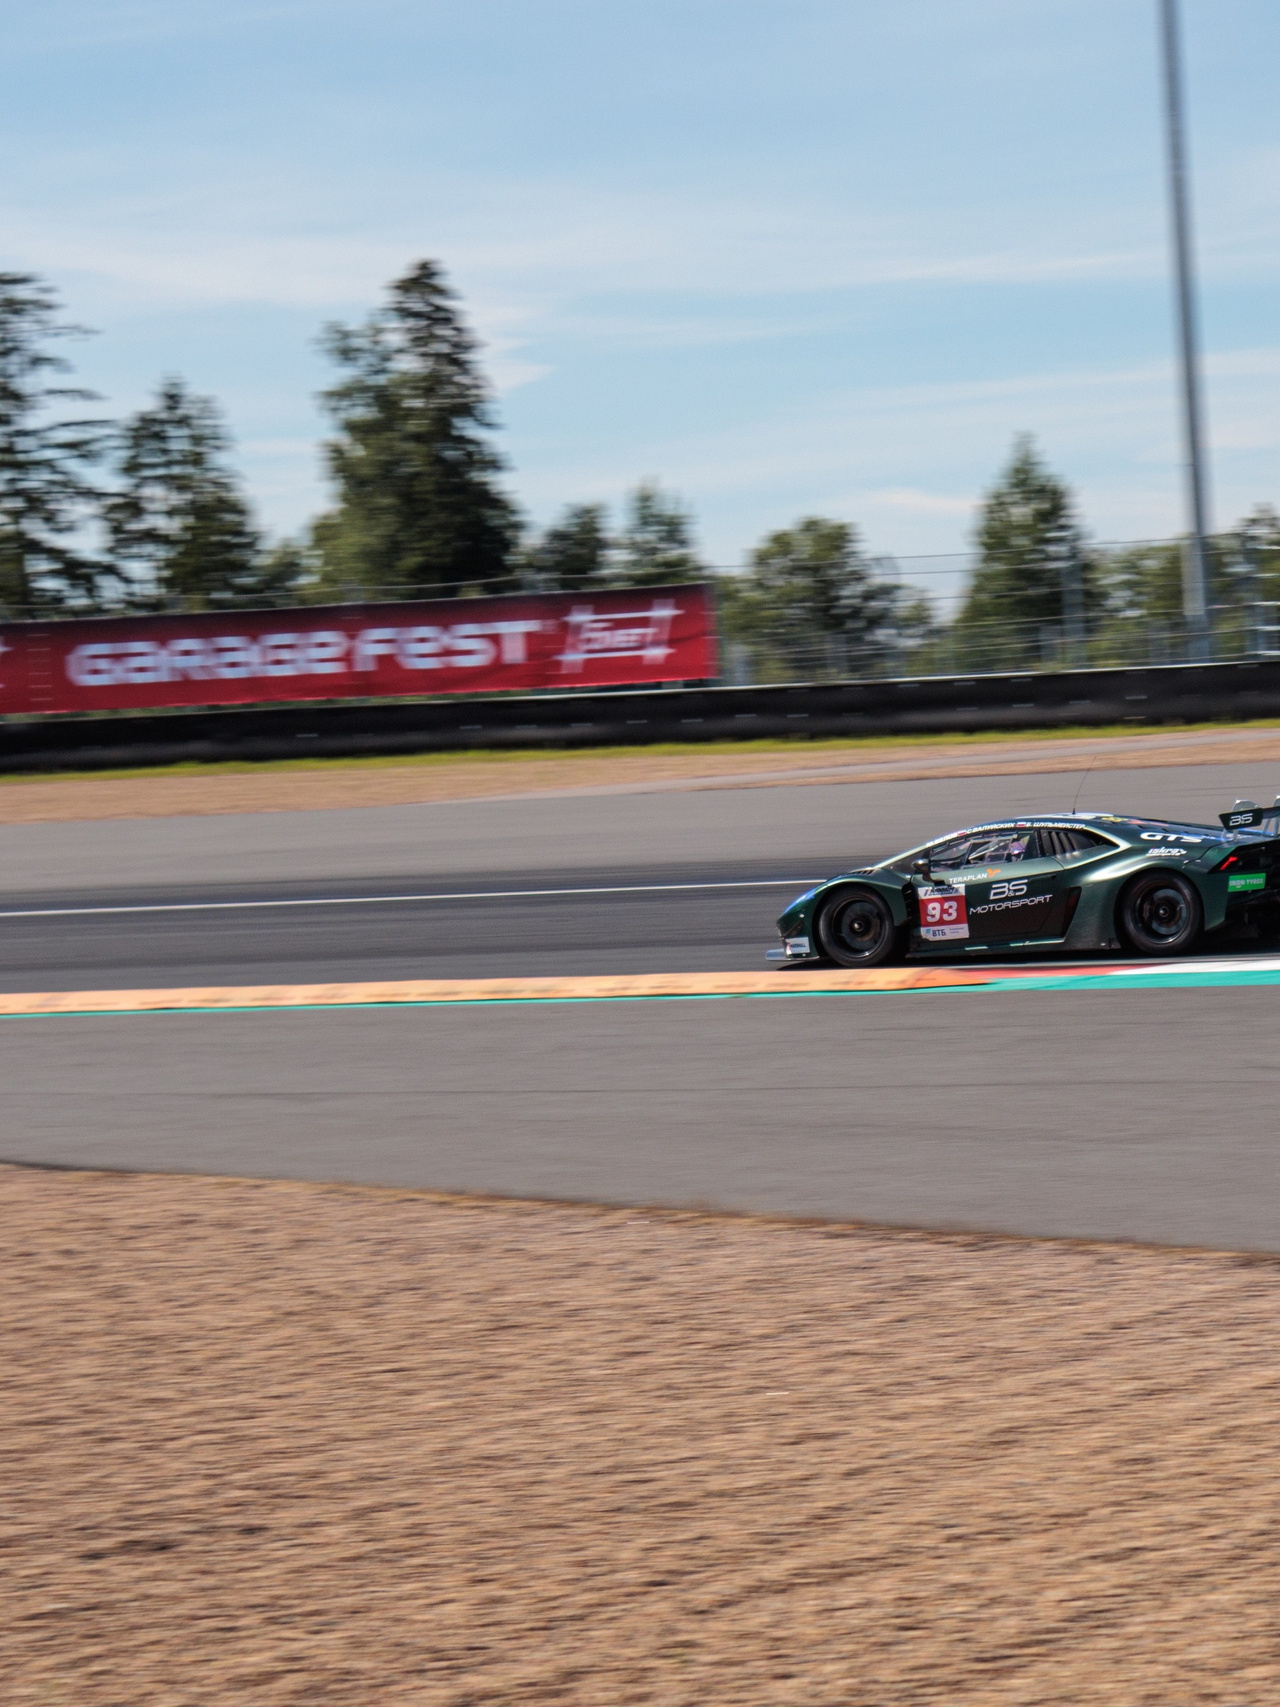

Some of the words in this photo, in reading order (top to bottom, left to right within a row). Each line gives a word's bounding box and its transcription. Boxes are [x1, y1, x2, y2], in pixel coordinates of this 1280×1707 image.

[948, 873, 988, 885] TERAPLAN
[989, 879, 1029, 900] B&S
[926, 901, 958, 923] 93
[969, 894, 1054, 915] MOTORSPORT
[931, 929, 947, 938] ВТБ
